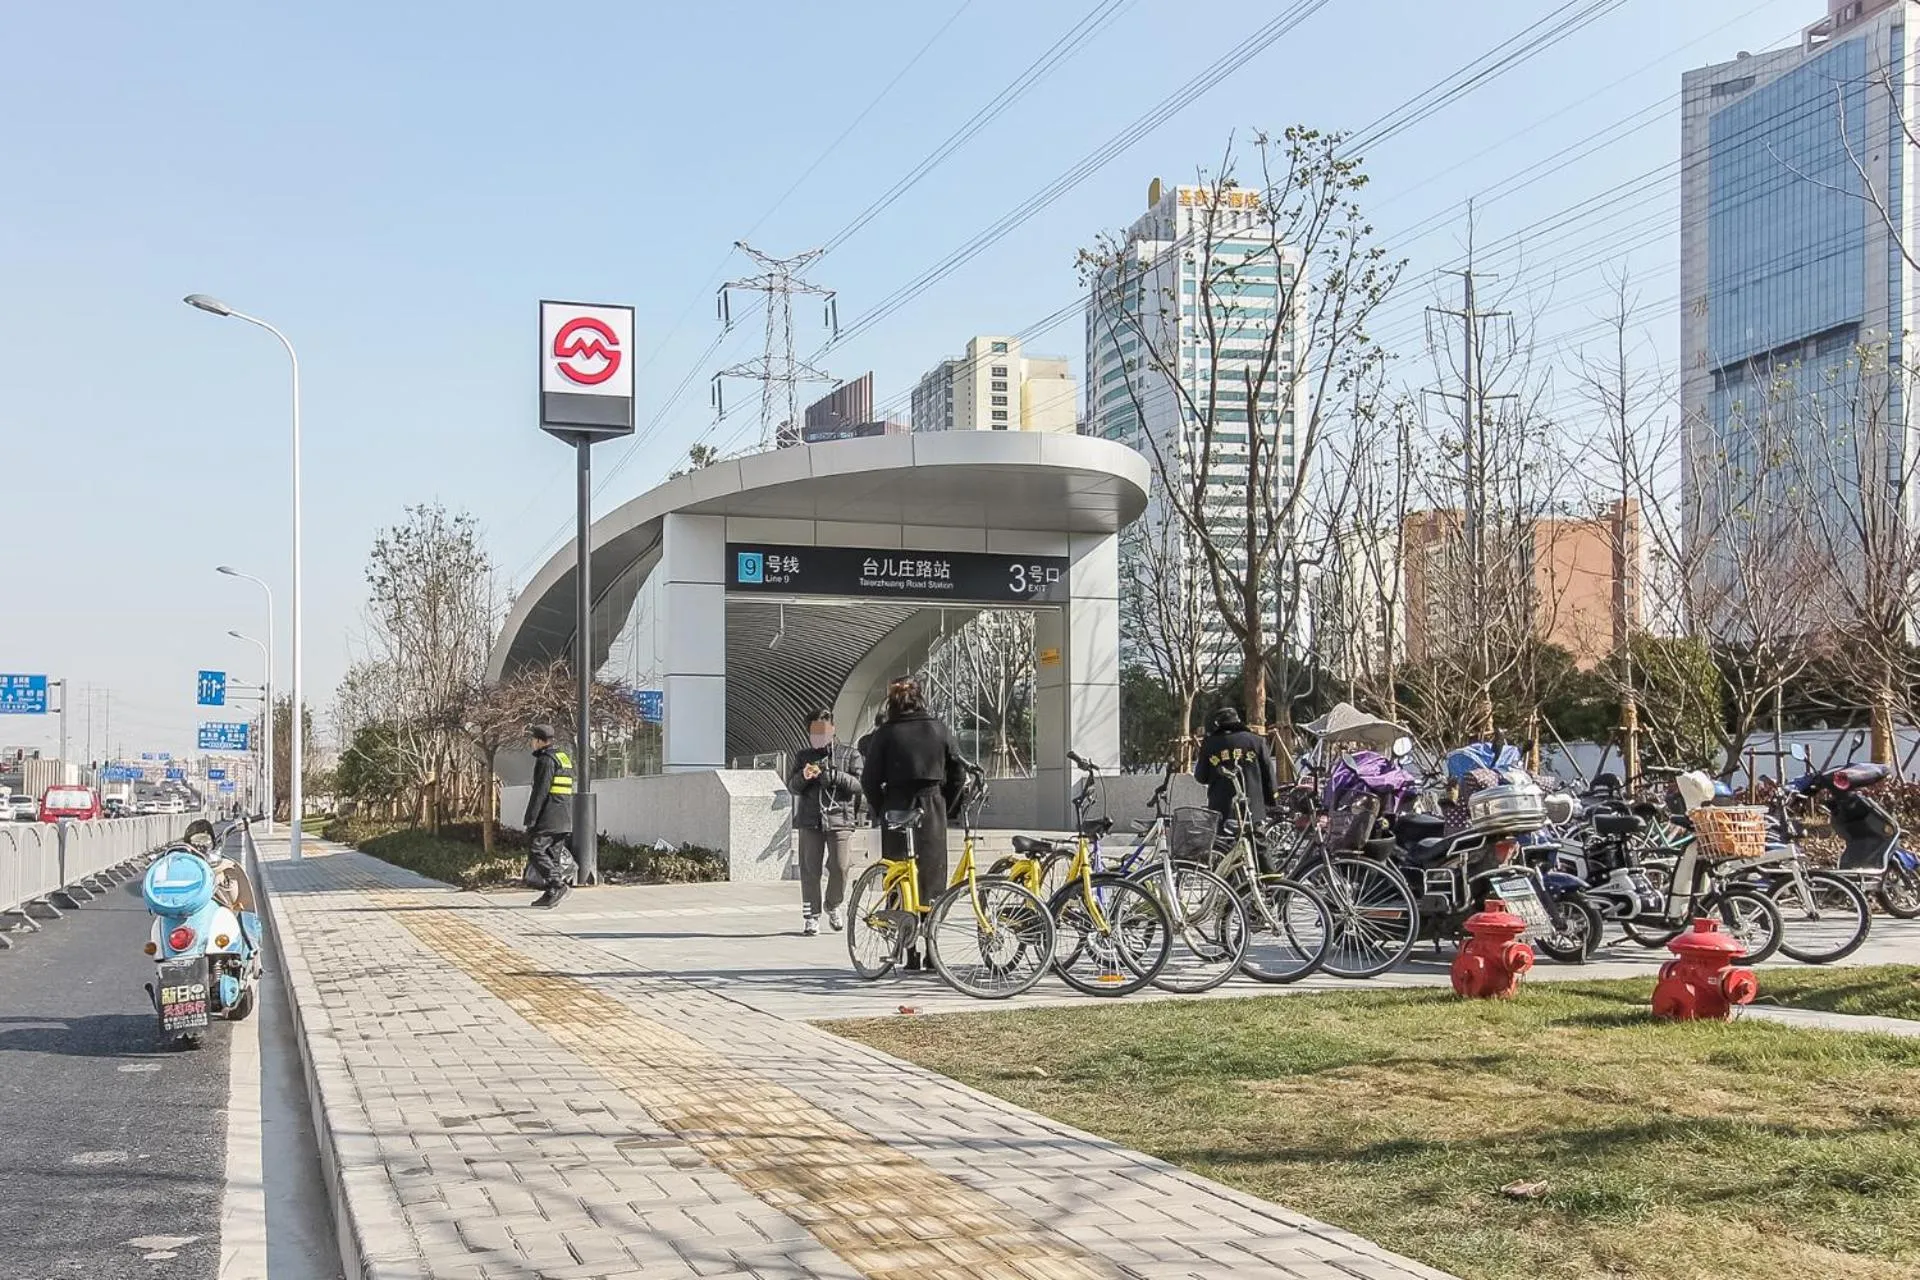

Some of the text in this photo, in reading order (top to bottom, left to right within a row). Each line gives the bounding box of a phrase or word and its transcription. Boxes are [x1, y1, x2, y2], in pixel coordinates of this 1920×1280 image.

[745, 558, 756, 576] 9
[863, 557, 951, 579] 台儿庄路站
[765, 574, 790, 583] Line 9
[859, 577, 954, 589] Taierzhuang Road Station
[1028, 584, 1047, 592] EXIT
[162, 986, 189, 1005] 新日
